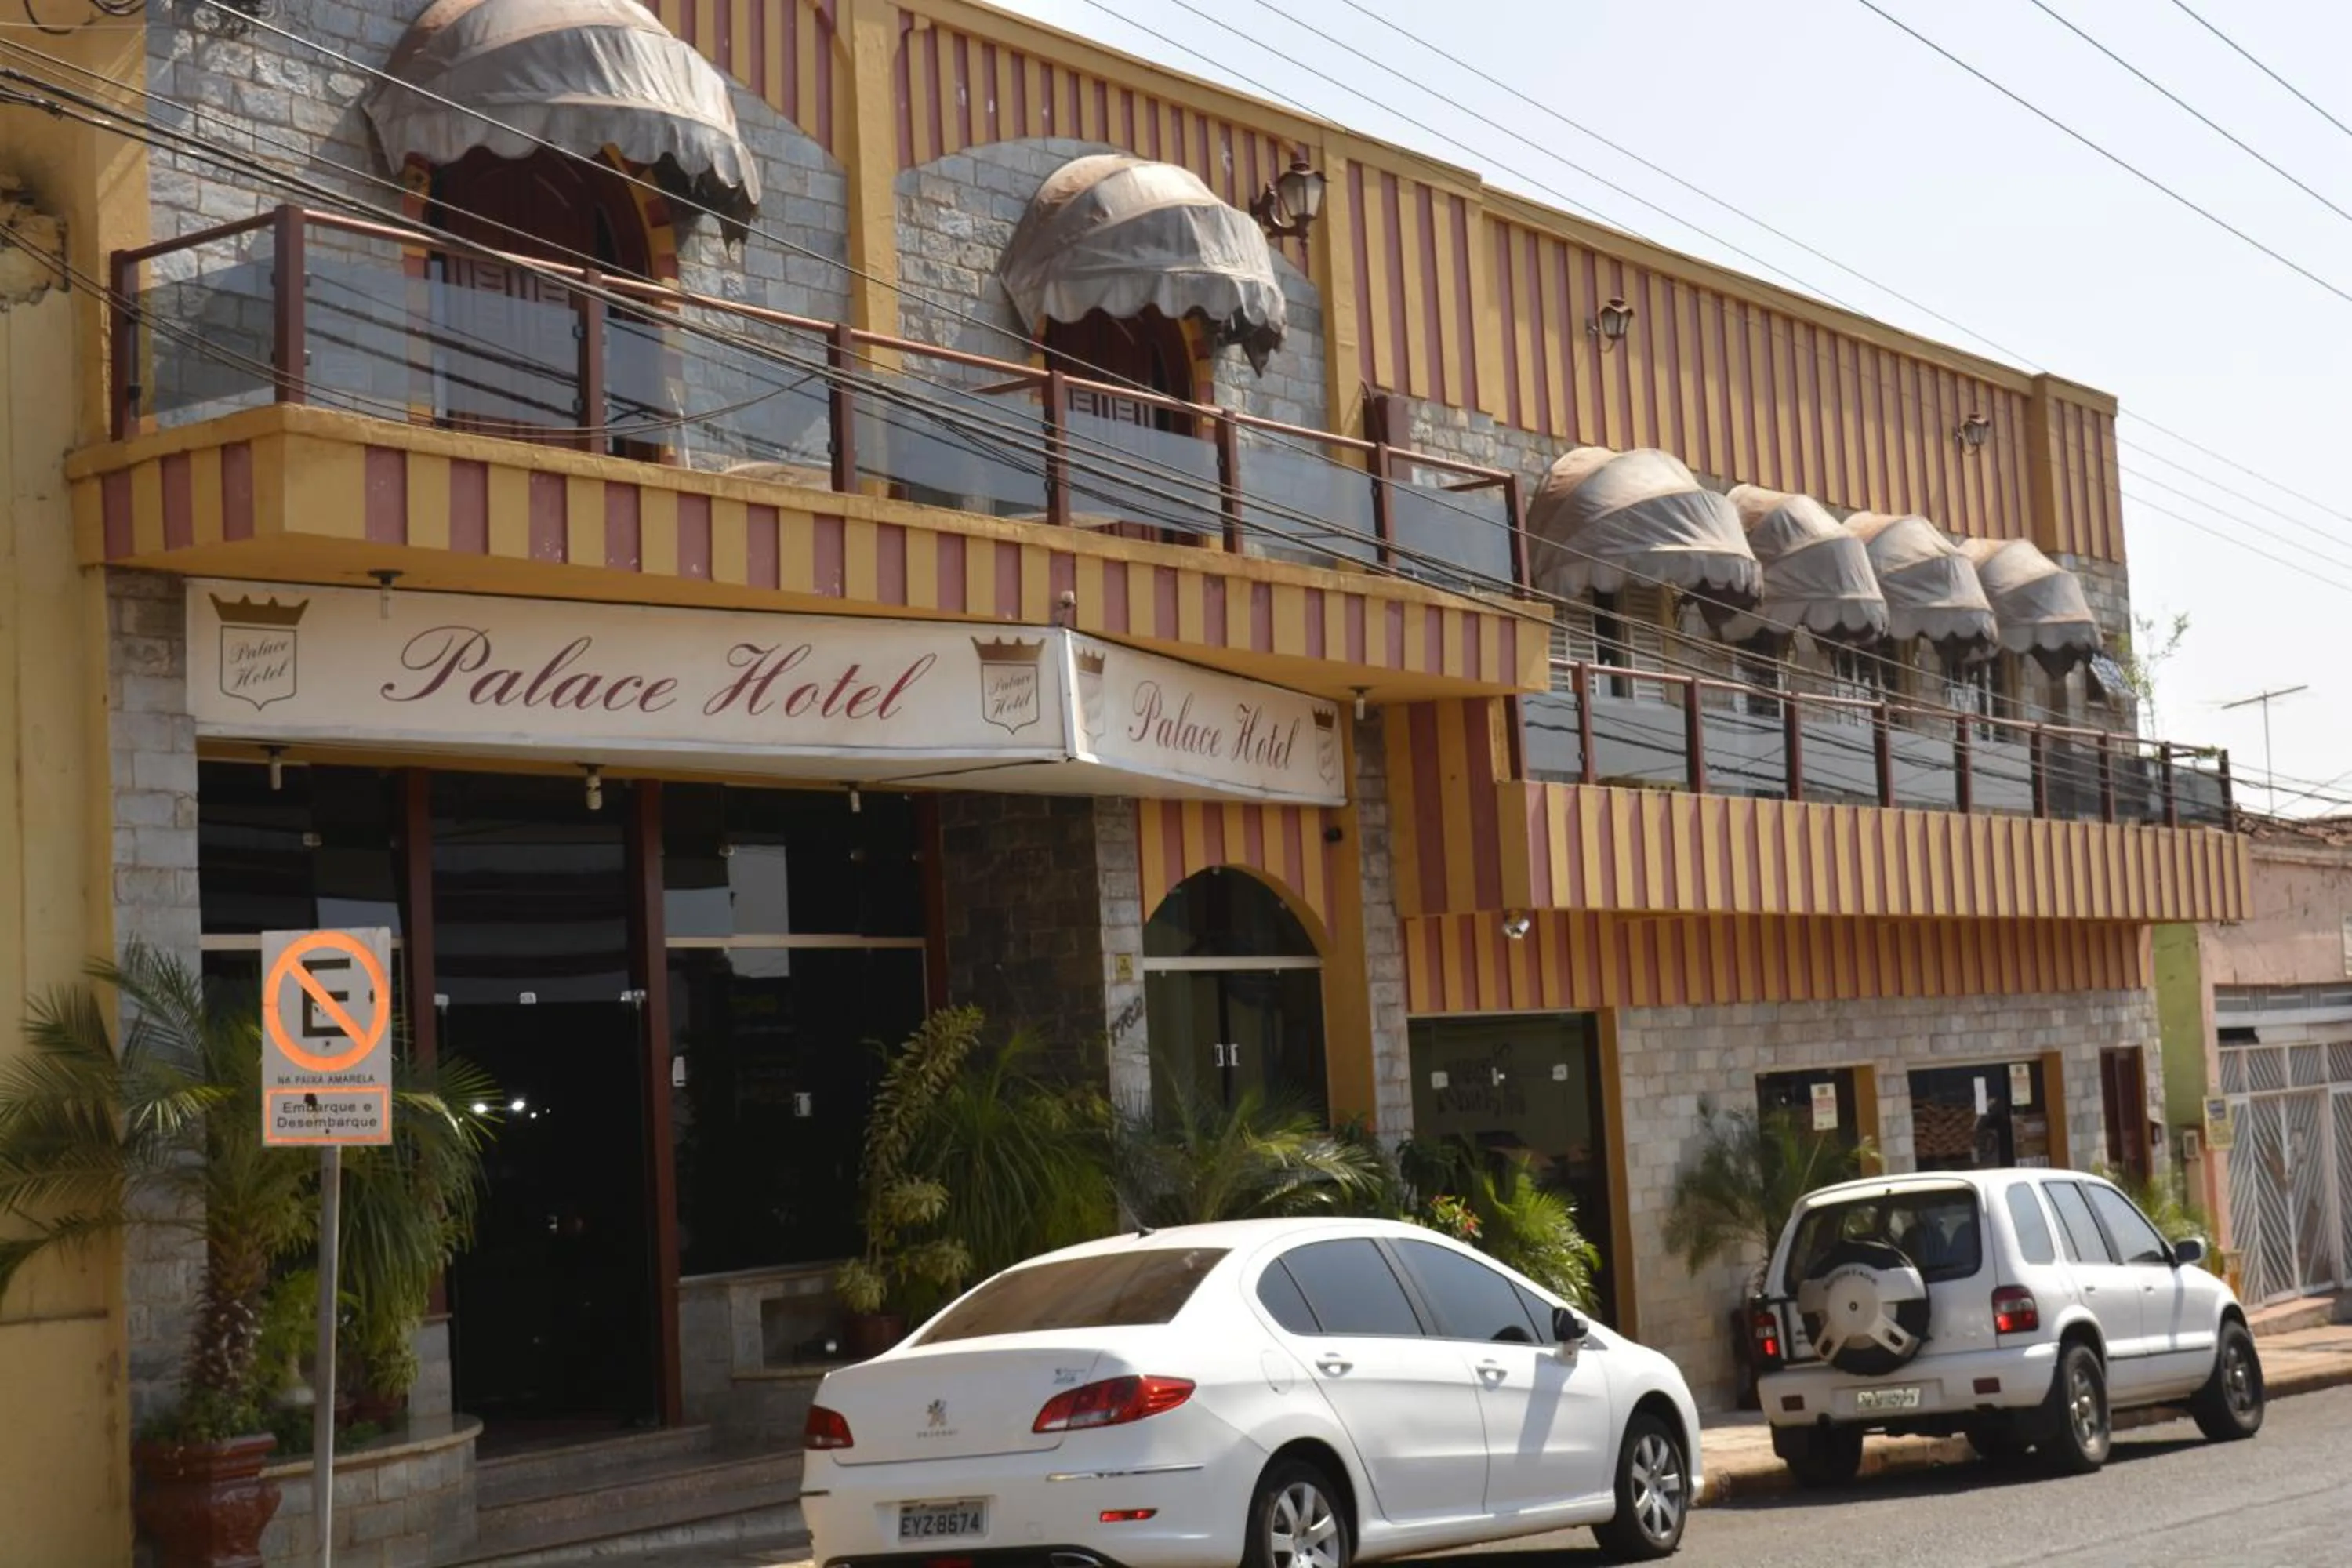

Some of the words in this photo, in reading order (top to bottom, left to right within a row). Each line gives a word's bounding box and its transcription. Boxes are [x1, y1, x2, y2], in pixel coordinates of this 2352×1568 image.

[228, 637, 289, 664] Palace
[230, 657, 292, 690] Hotel
[380, 625, 679, 713] Palace
[702, 642, 938, 720] Hotel
[1127, 680, 1223, 758] Palace
[1231, 702, 1301, 771] Hotel
[277, 1116, 378, 1129] Desembarque
[282, 1101, 356, 1114] Embarque
[363, 1103, 372, 1112] e
